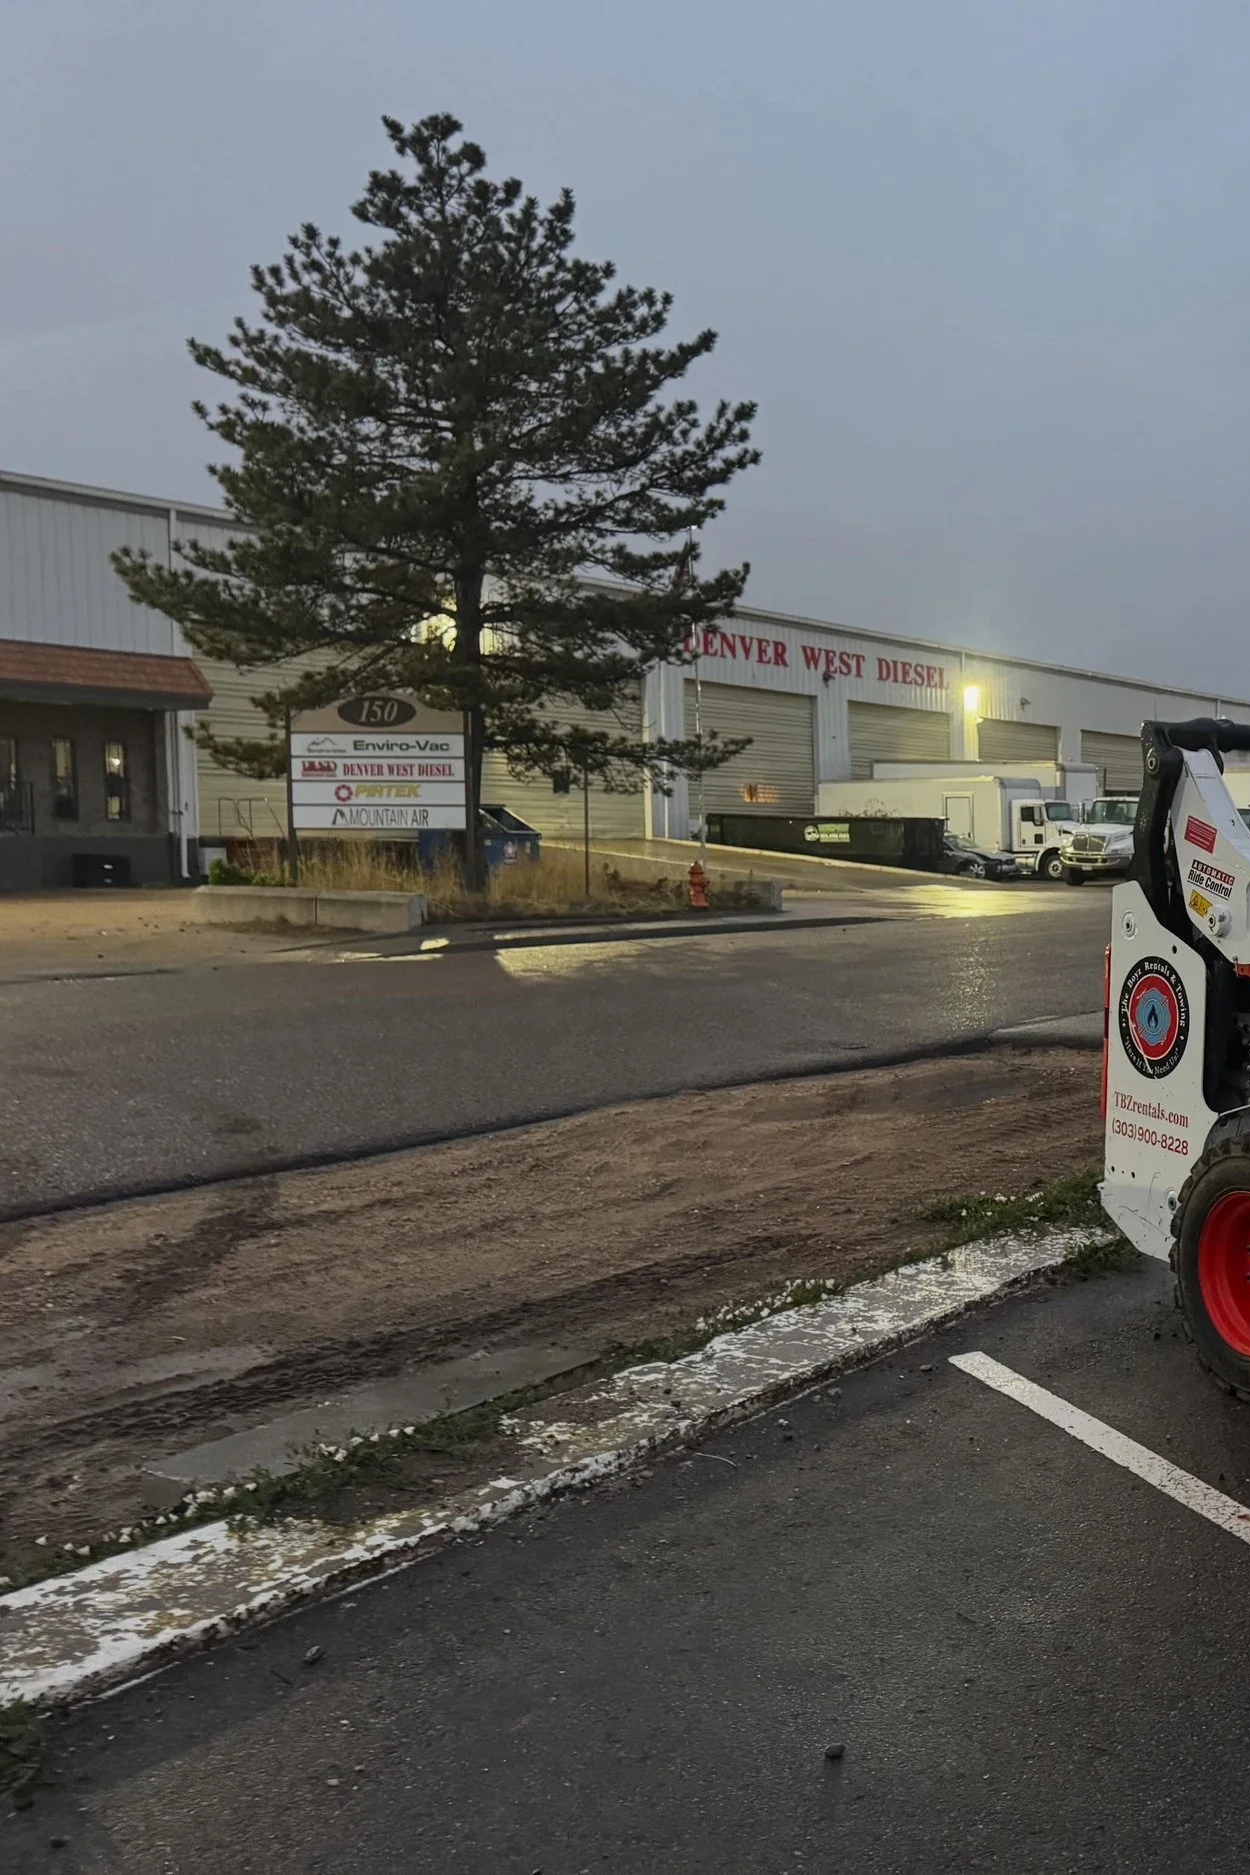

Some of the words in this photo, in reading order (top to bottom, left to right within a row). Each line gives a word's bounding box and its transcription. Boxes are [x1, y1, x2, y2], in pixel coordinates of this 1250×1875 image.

[801, 645, 866, 678] WEST
[876, 657, 949, 690] DIESEL
[359, 700, 398, 723] 150
[353, 740, 450, 751] Enviro-Vac
[343, 763, 384, 776] DENVER
[387, 764, 415, 777] WEST
[418, 763, 454, 777] DIESEL
[350, 808, 408, 826] MOUNTAIN
[411, 808, 429, 826] AIR
[1188, 870, 1204, 886] Ride
[1204, 876, 1232, 898] Control
[1191, 859, 1235, 886] AUTOMATIC
[1121, 992, 1130, 1014] The
[1127, 968, 1142, 989] Boyz
[1144, 961, 1170, 977] Rentals
[1170, 974, 1177, 985] &
[1175, 983, 1186, 1027] Towing
[1154, 1062, 1170, 1075] Need
[1114, 1091, 1189, 1128] TBZrentals.com
[1112, 1119, 1189, 1155] (303)900-8228
